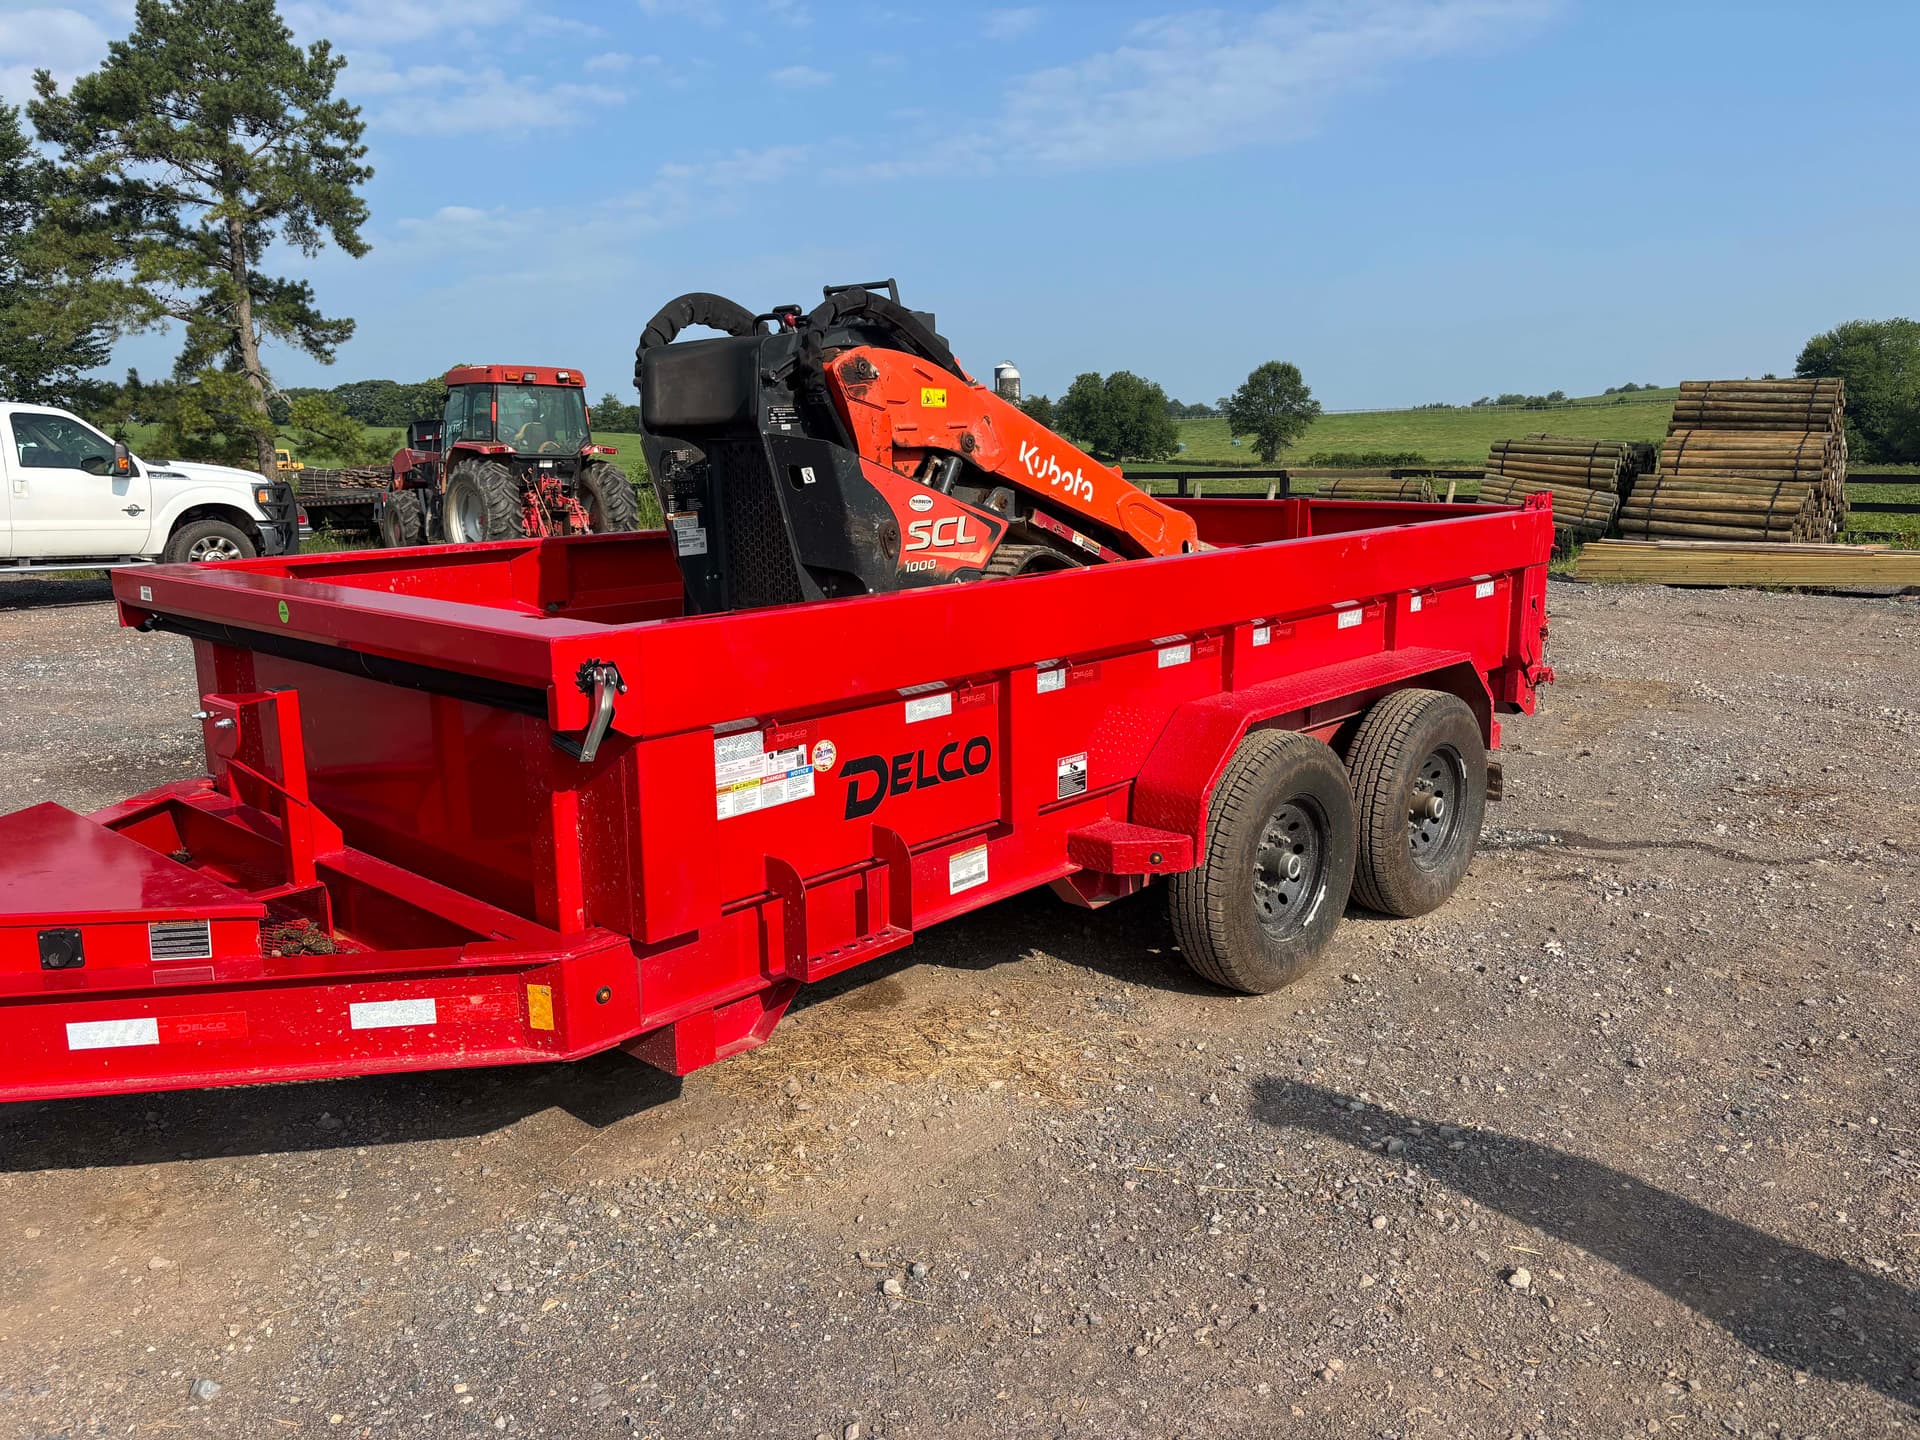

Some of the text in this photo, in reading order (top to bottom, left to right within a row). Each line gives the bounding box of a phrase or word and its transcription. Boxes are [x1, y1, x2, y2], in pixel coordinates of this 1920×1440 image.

[1019, 440, 1093, 502] Kubota
[905, 516, 976, 551] SCL
[905, 559, 936, 572] 1000
[776, 729, 807, 742] DELCO
[791, 767, 809, 777] NOTICE
[838, 735, 992, 821] DELCO
[176, 1022, 227, 1034] DELCO
